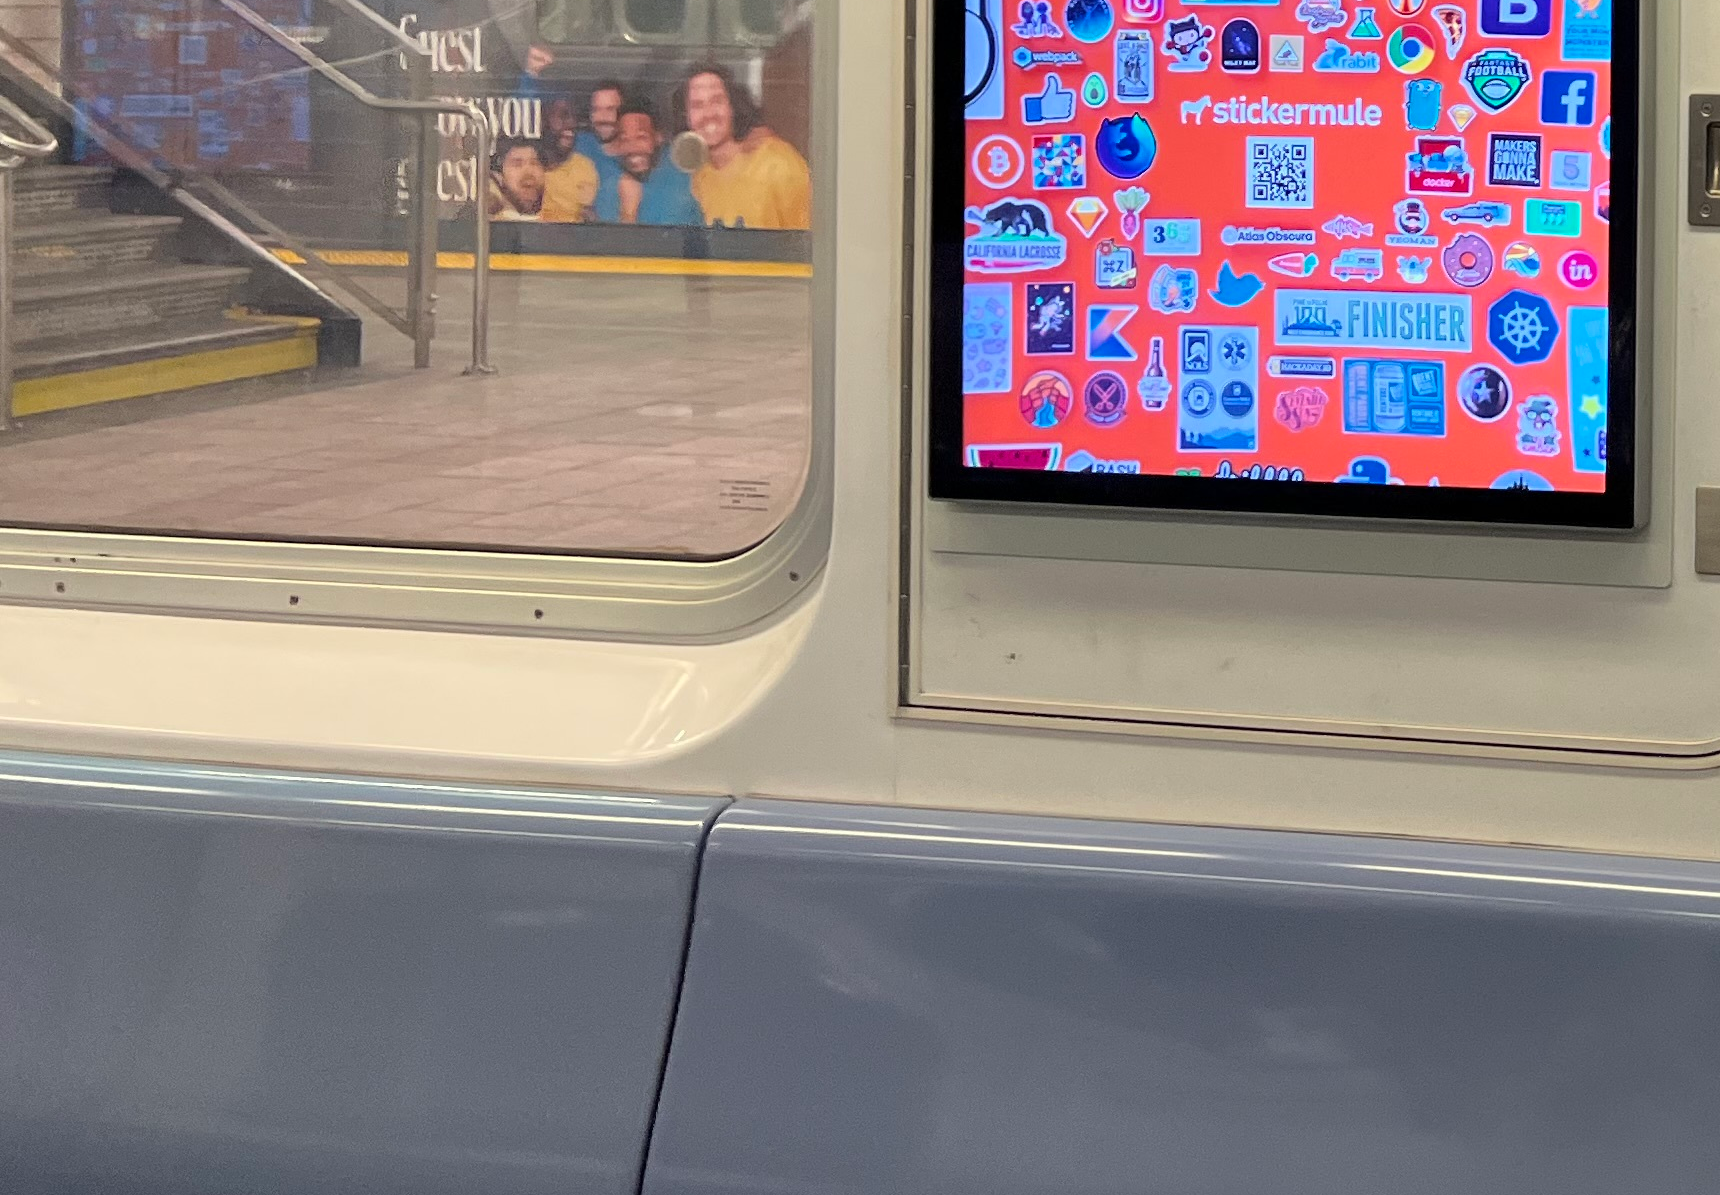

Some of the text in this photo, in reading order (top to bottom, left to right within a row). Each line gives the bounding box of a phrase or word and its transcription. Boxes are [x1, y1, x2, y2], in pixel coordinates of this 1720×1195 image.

[1468, 64, 1527, 79] FOOTBALL
[1213, 95, 1383, 126] stickermule
[1494, 140, 1537, 152] MAKERS
[1493, 150, 1536, 166] GONNA
[1237, 231, 1313, 242] Atlas Obscura
[1388, 236, 1436, 246] YEOMAN
[967, 244, 1062, 260] CALIFORNIA LACROSSE
[1347, 299, 1466, 343] FINISHER
